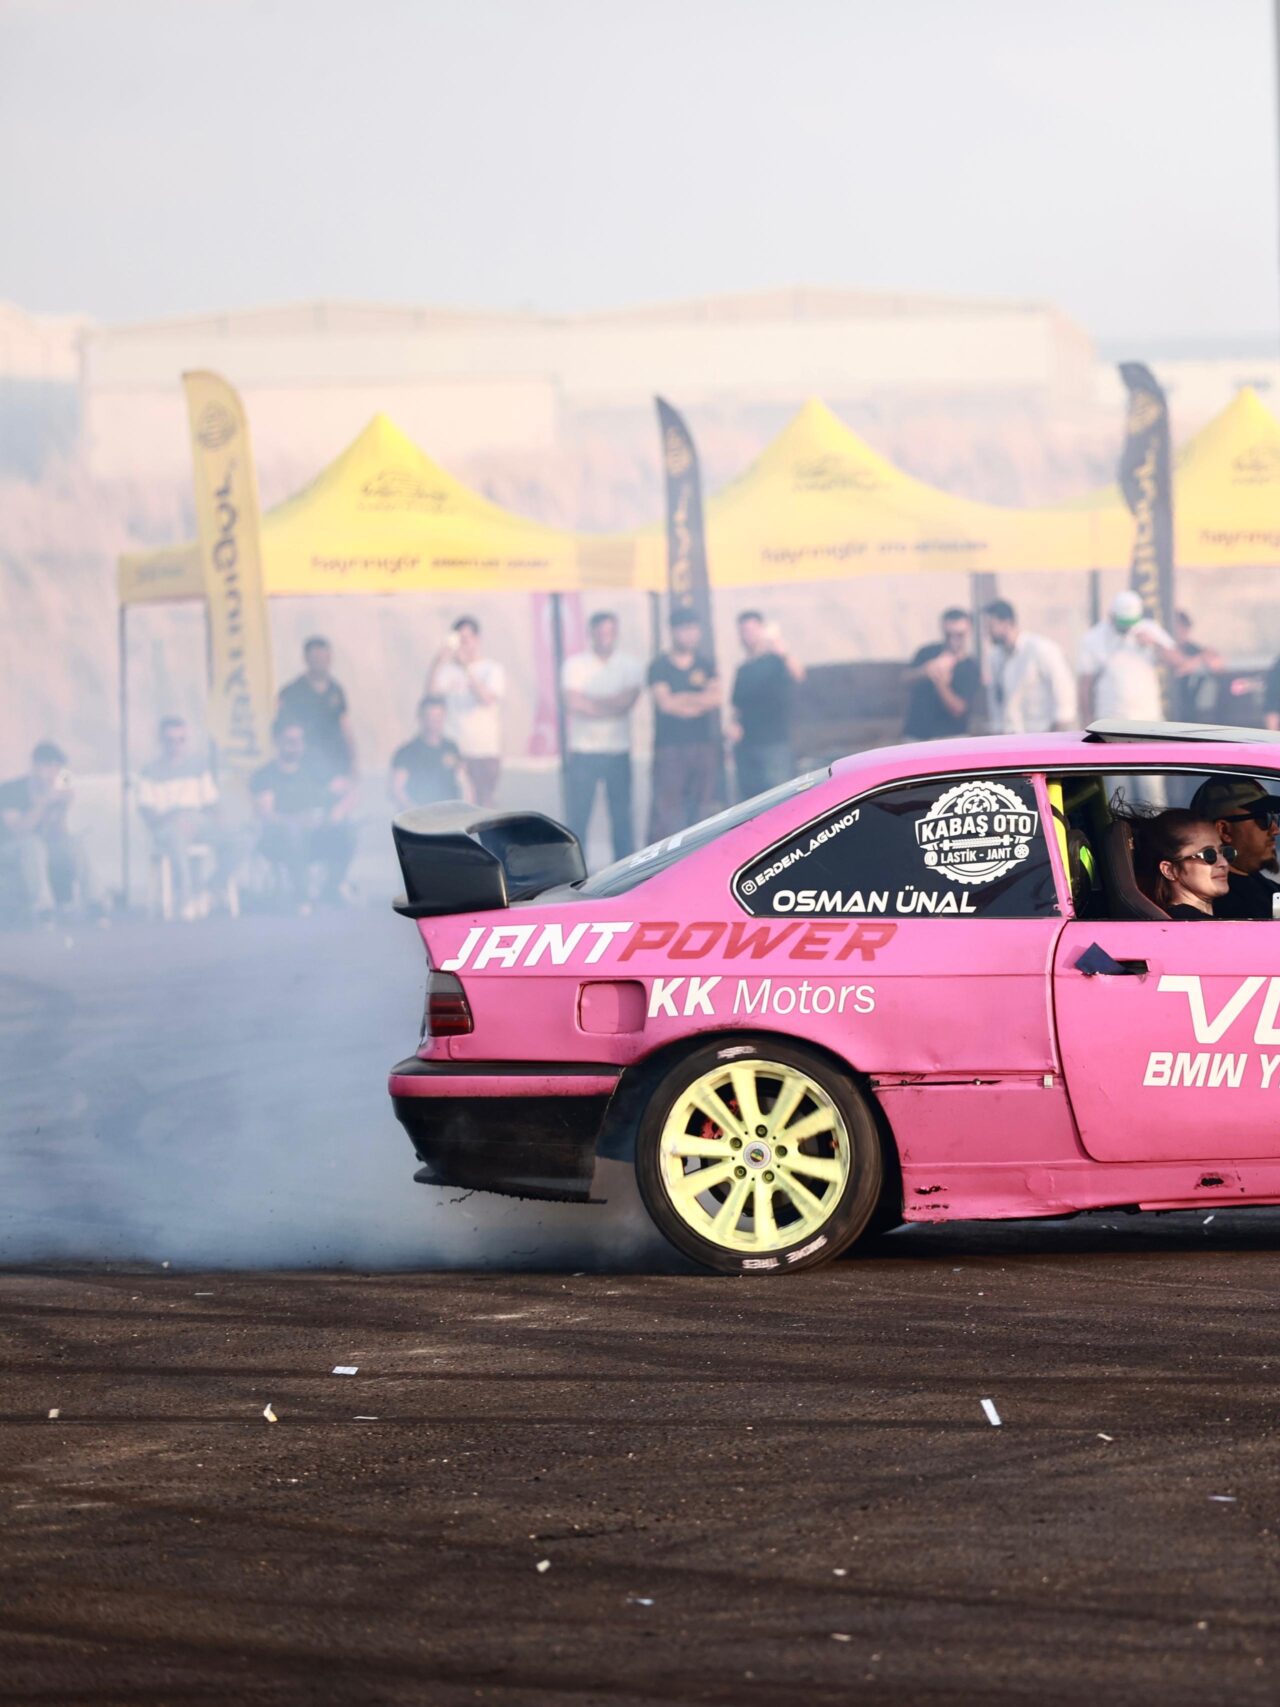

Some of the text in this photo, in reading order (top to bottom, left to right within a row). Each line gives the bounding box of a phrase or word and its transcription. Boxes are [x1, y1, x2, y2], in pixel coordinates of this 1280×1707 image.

[922, 814, 1031, 843] KABAŞ OTO
[941, 848, 977, 864] LASTİK
[986, 847, 1012, 861] JANT
[772, 886, 977, 913] OSMAN ÜNAL
[647, 976, 877, 1018] KK Motors
[1143, 1052, 1249, 1088] BMW
